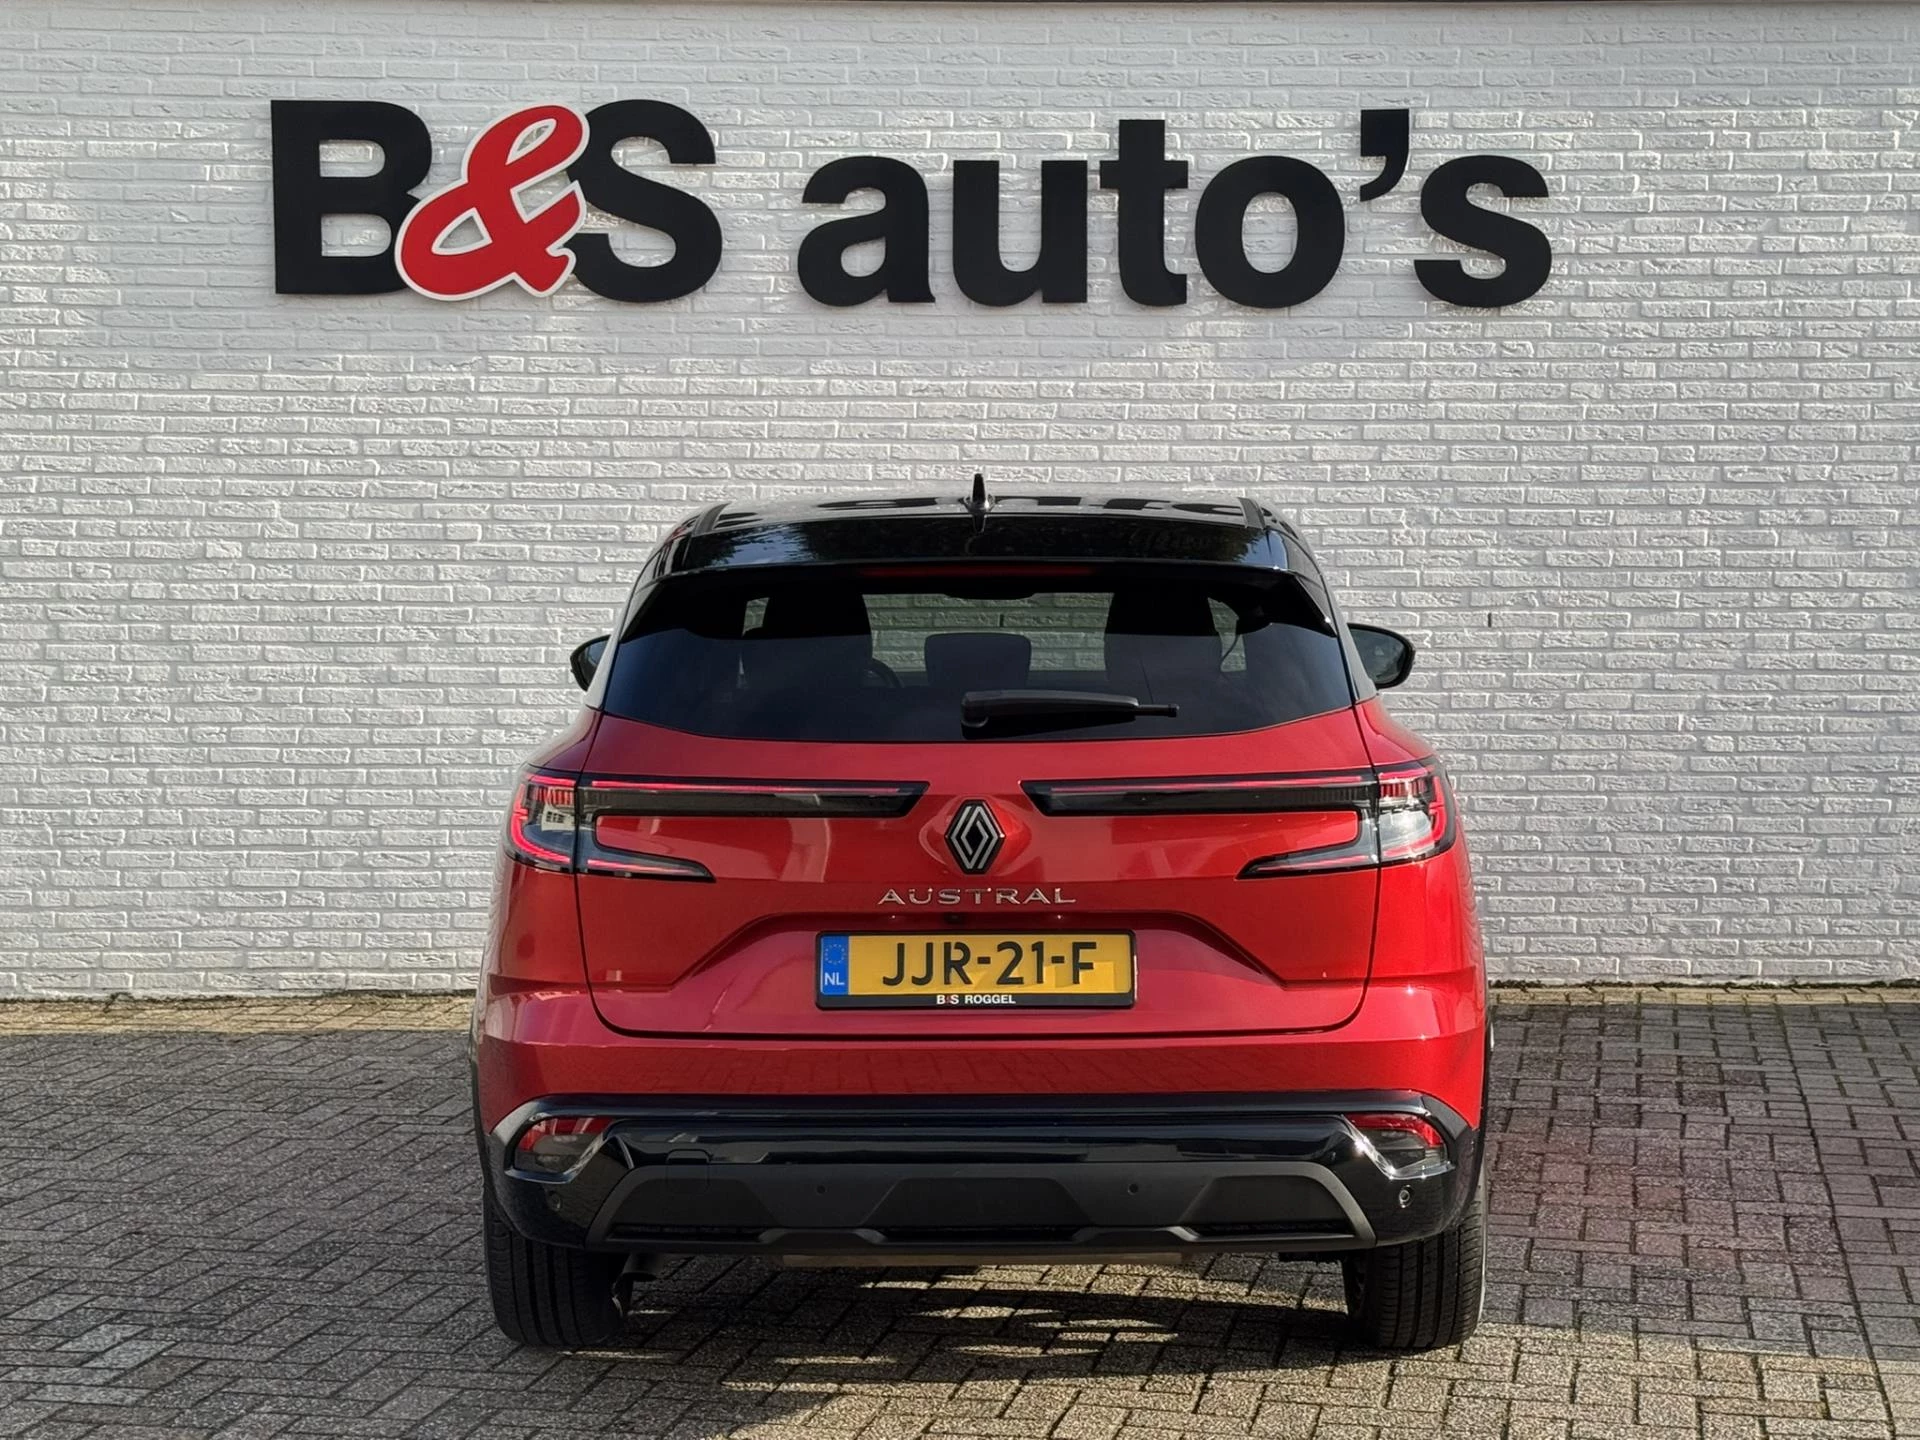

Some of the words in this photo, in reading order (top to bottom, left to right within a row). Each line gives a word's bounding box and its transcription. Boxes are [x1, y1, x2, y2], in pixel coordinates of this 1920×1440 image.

[271, 99, 722, 302] B&S
[797, 109, 1553, 309] auto's
[878, 887, 1076, 905] AUSTRAL
[882, 941, 1097, 986] JJR-21-F
[824, 972, 845, 986] NL
[936, 994, 960, 1005] BS
[964, 994, 1016, 1005] ROGGEL
